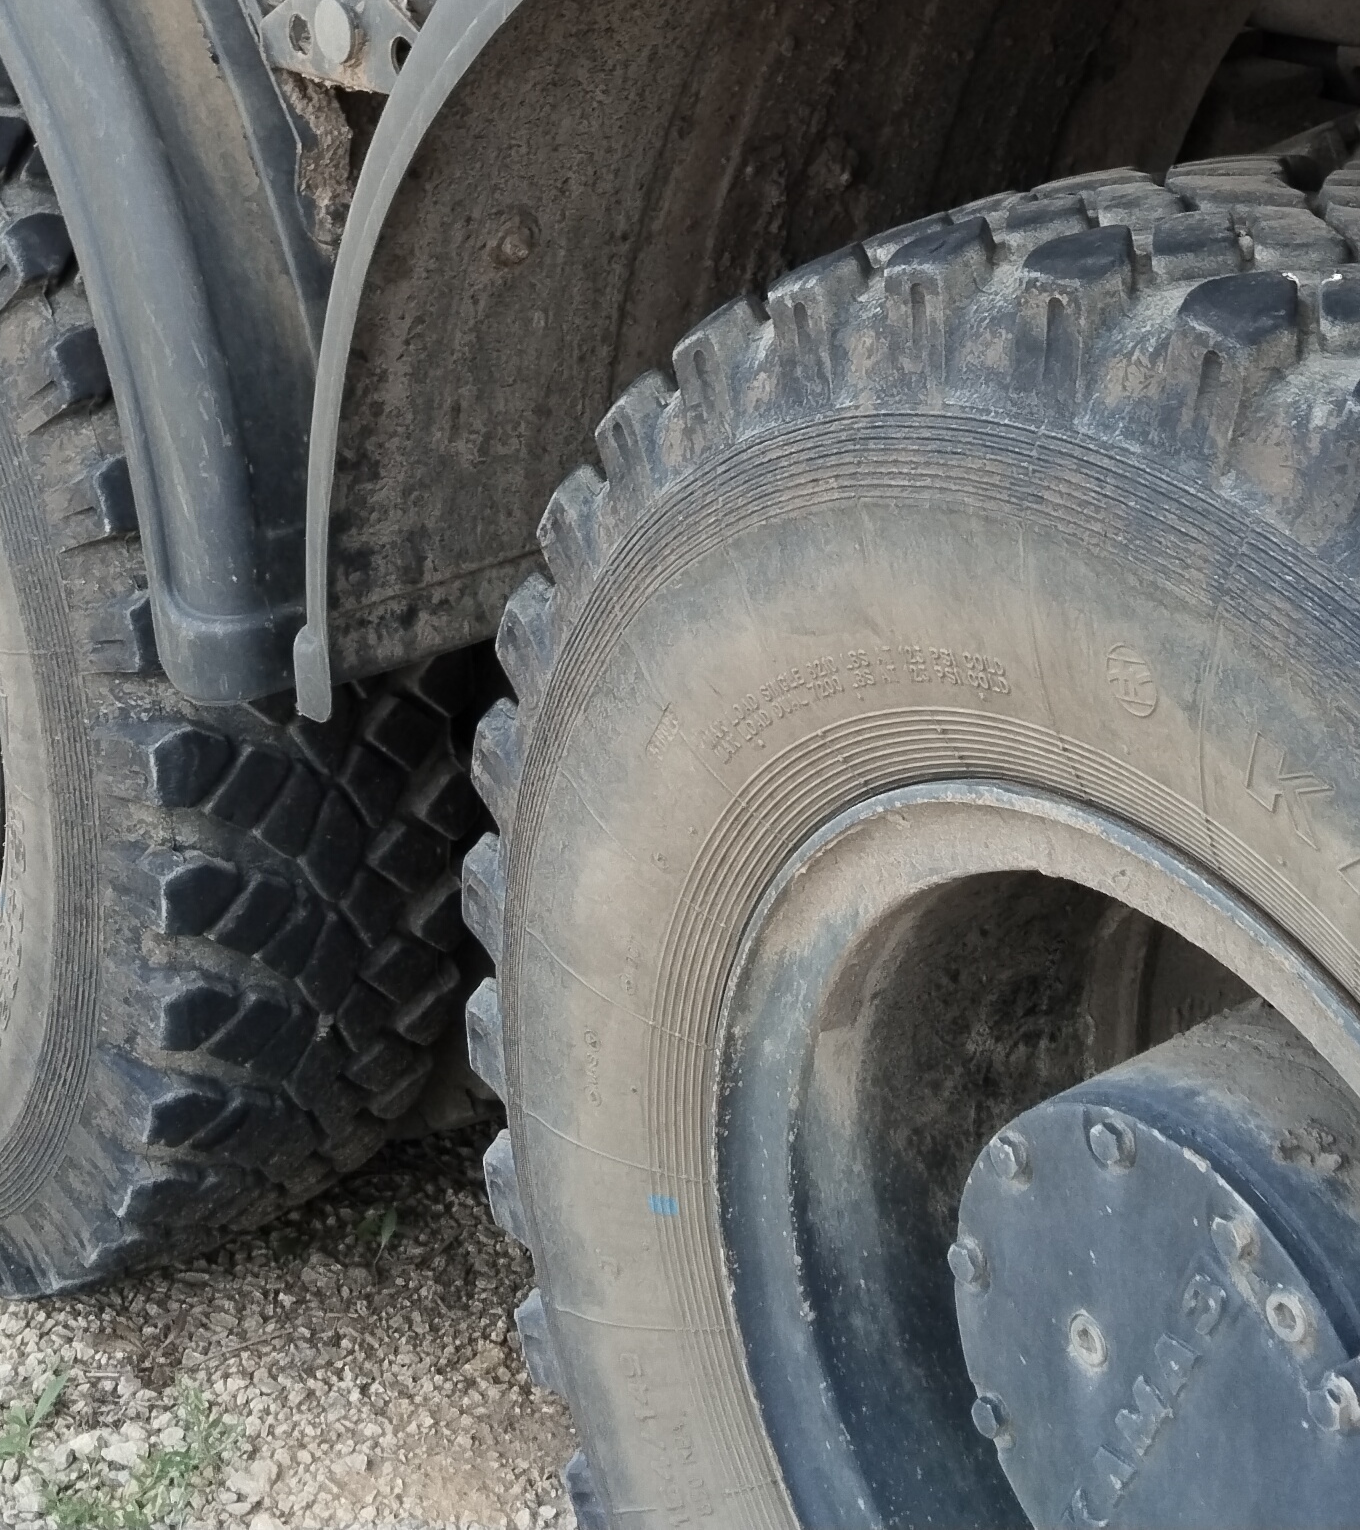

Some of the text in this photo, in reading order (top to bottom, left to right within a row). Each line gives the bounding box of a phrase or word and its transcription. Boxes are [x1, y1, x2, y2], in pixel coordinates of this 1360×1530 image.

[722, 691, 761, 727] LOAD
[756, 666, 805, 703] SINGLE
[736, 707, 774, 742] LOAD
